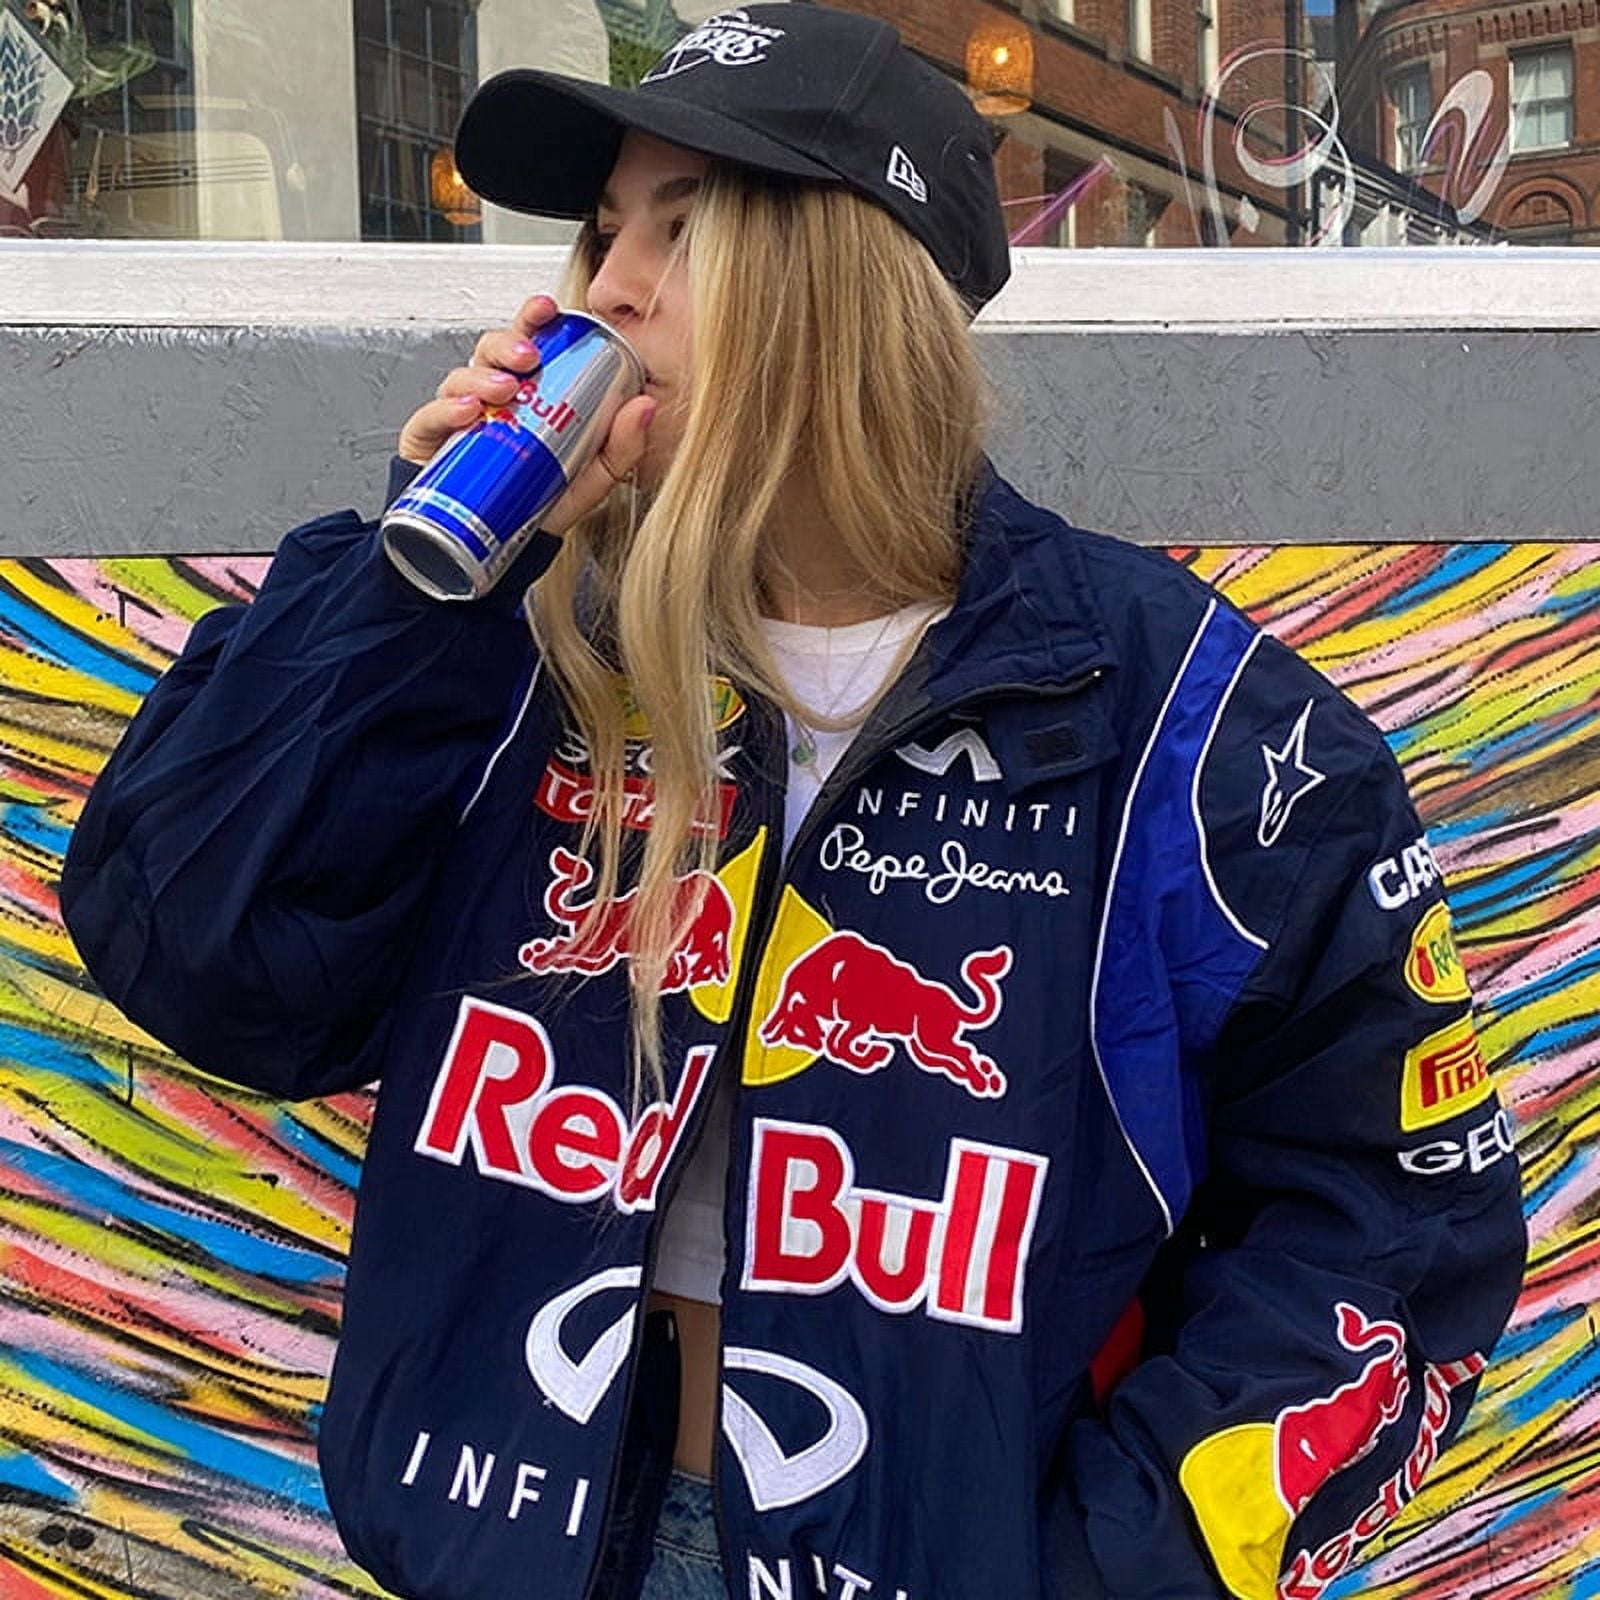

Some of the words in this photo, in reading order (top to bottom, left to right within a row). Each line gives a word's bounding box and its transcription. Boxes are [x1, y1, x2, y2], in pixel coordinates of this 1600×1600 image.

[820, 823, 929, 895] Pepe
[925, 841, 1070, 904] Jeans
[414, 995, 716, 1214] Red
[740, 1117, 1050, 1334] Bull
[400, 1430, 591, 1537] INFI
[747, 1550, 908, 1600] NIT
